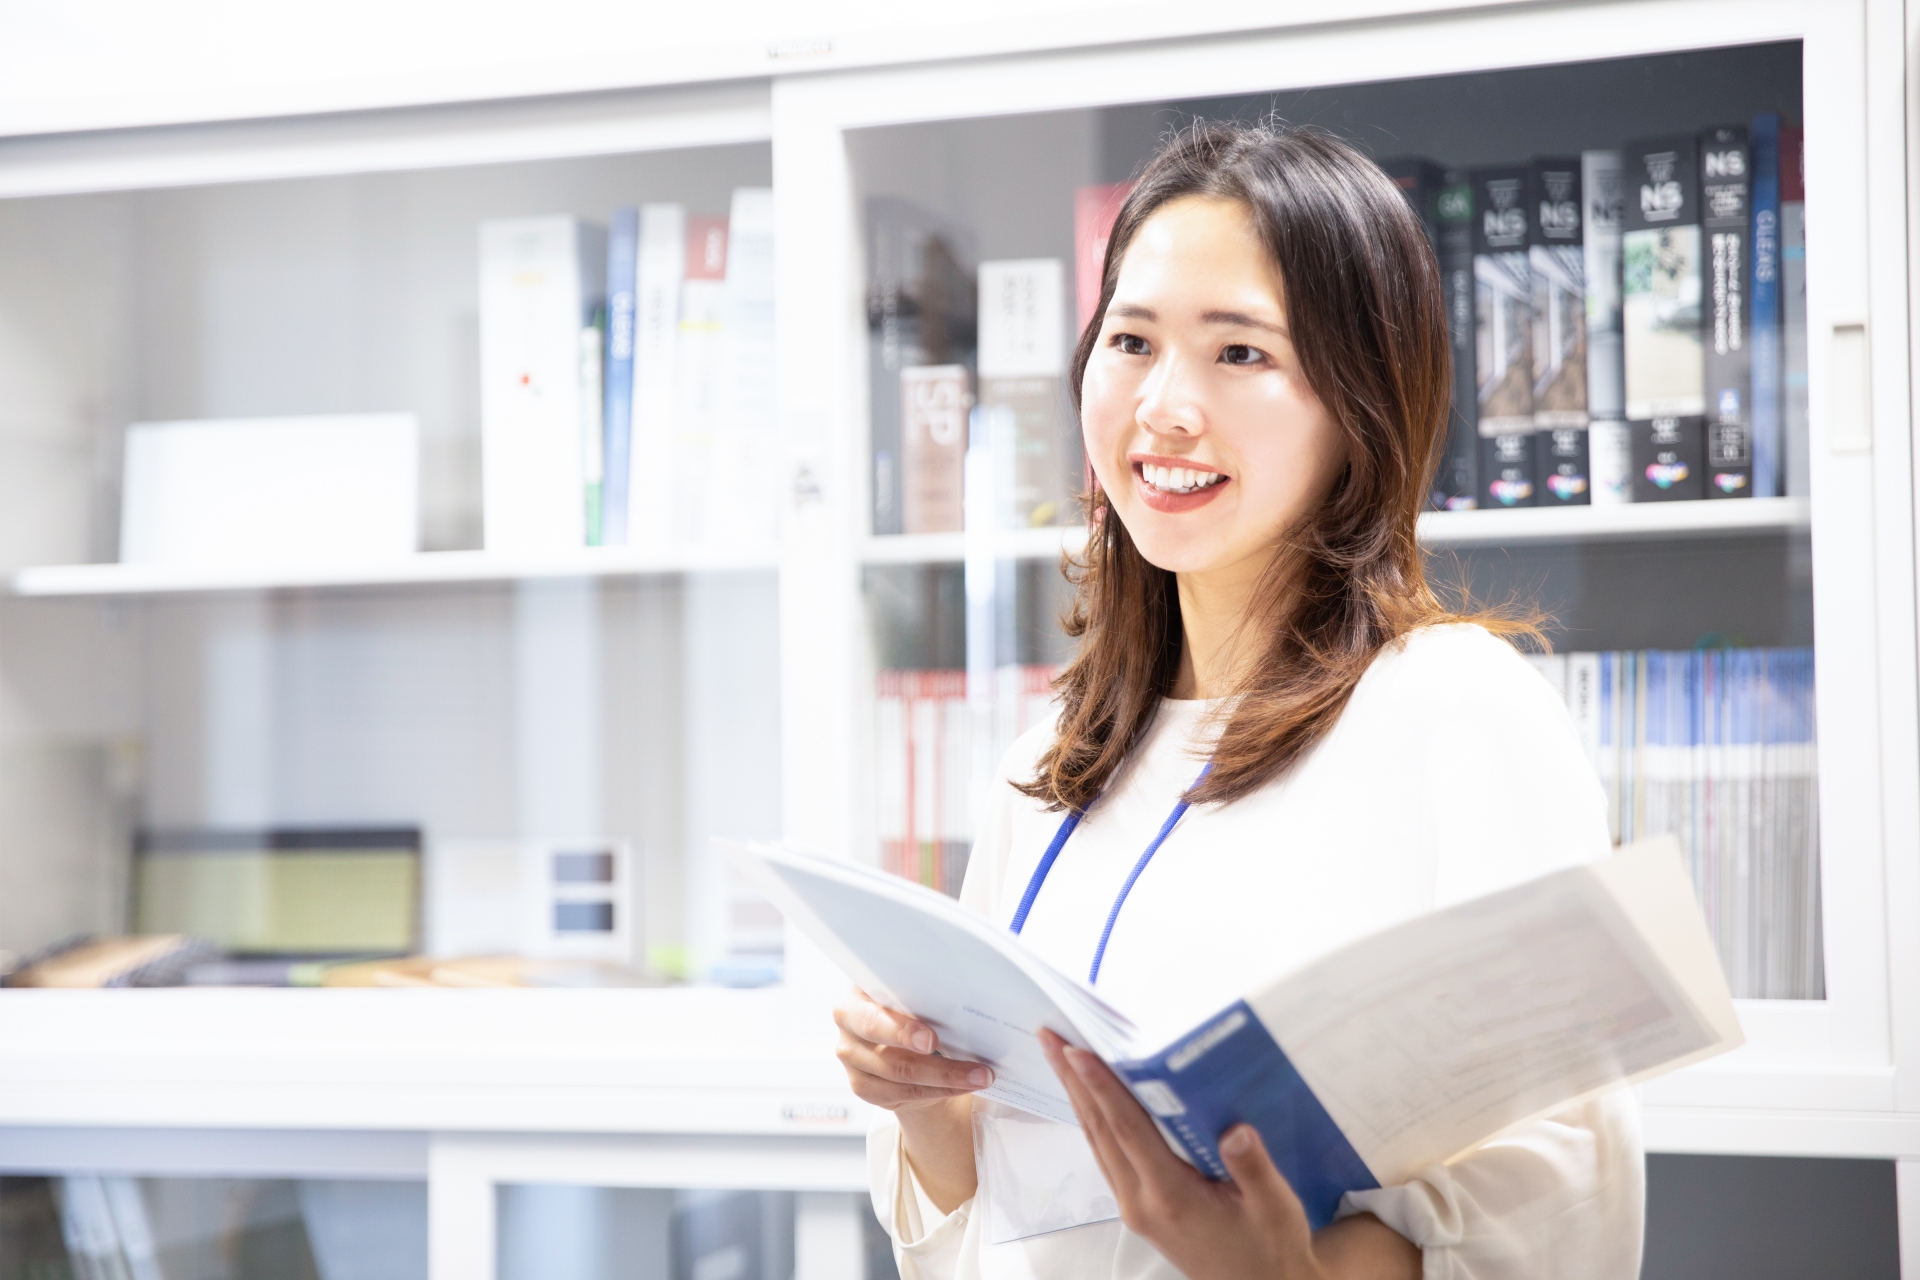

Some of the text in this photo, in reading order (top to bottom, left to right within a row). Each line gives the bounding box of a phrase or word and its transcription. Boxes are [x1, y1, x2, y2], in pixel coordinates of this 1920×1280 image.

[1705, 150, 1745, 177] NS
[1641, 181, 1684, 212] NS
[1484, 207, 1528, 238] NS
[1539, 200, 1579, 229] NS
